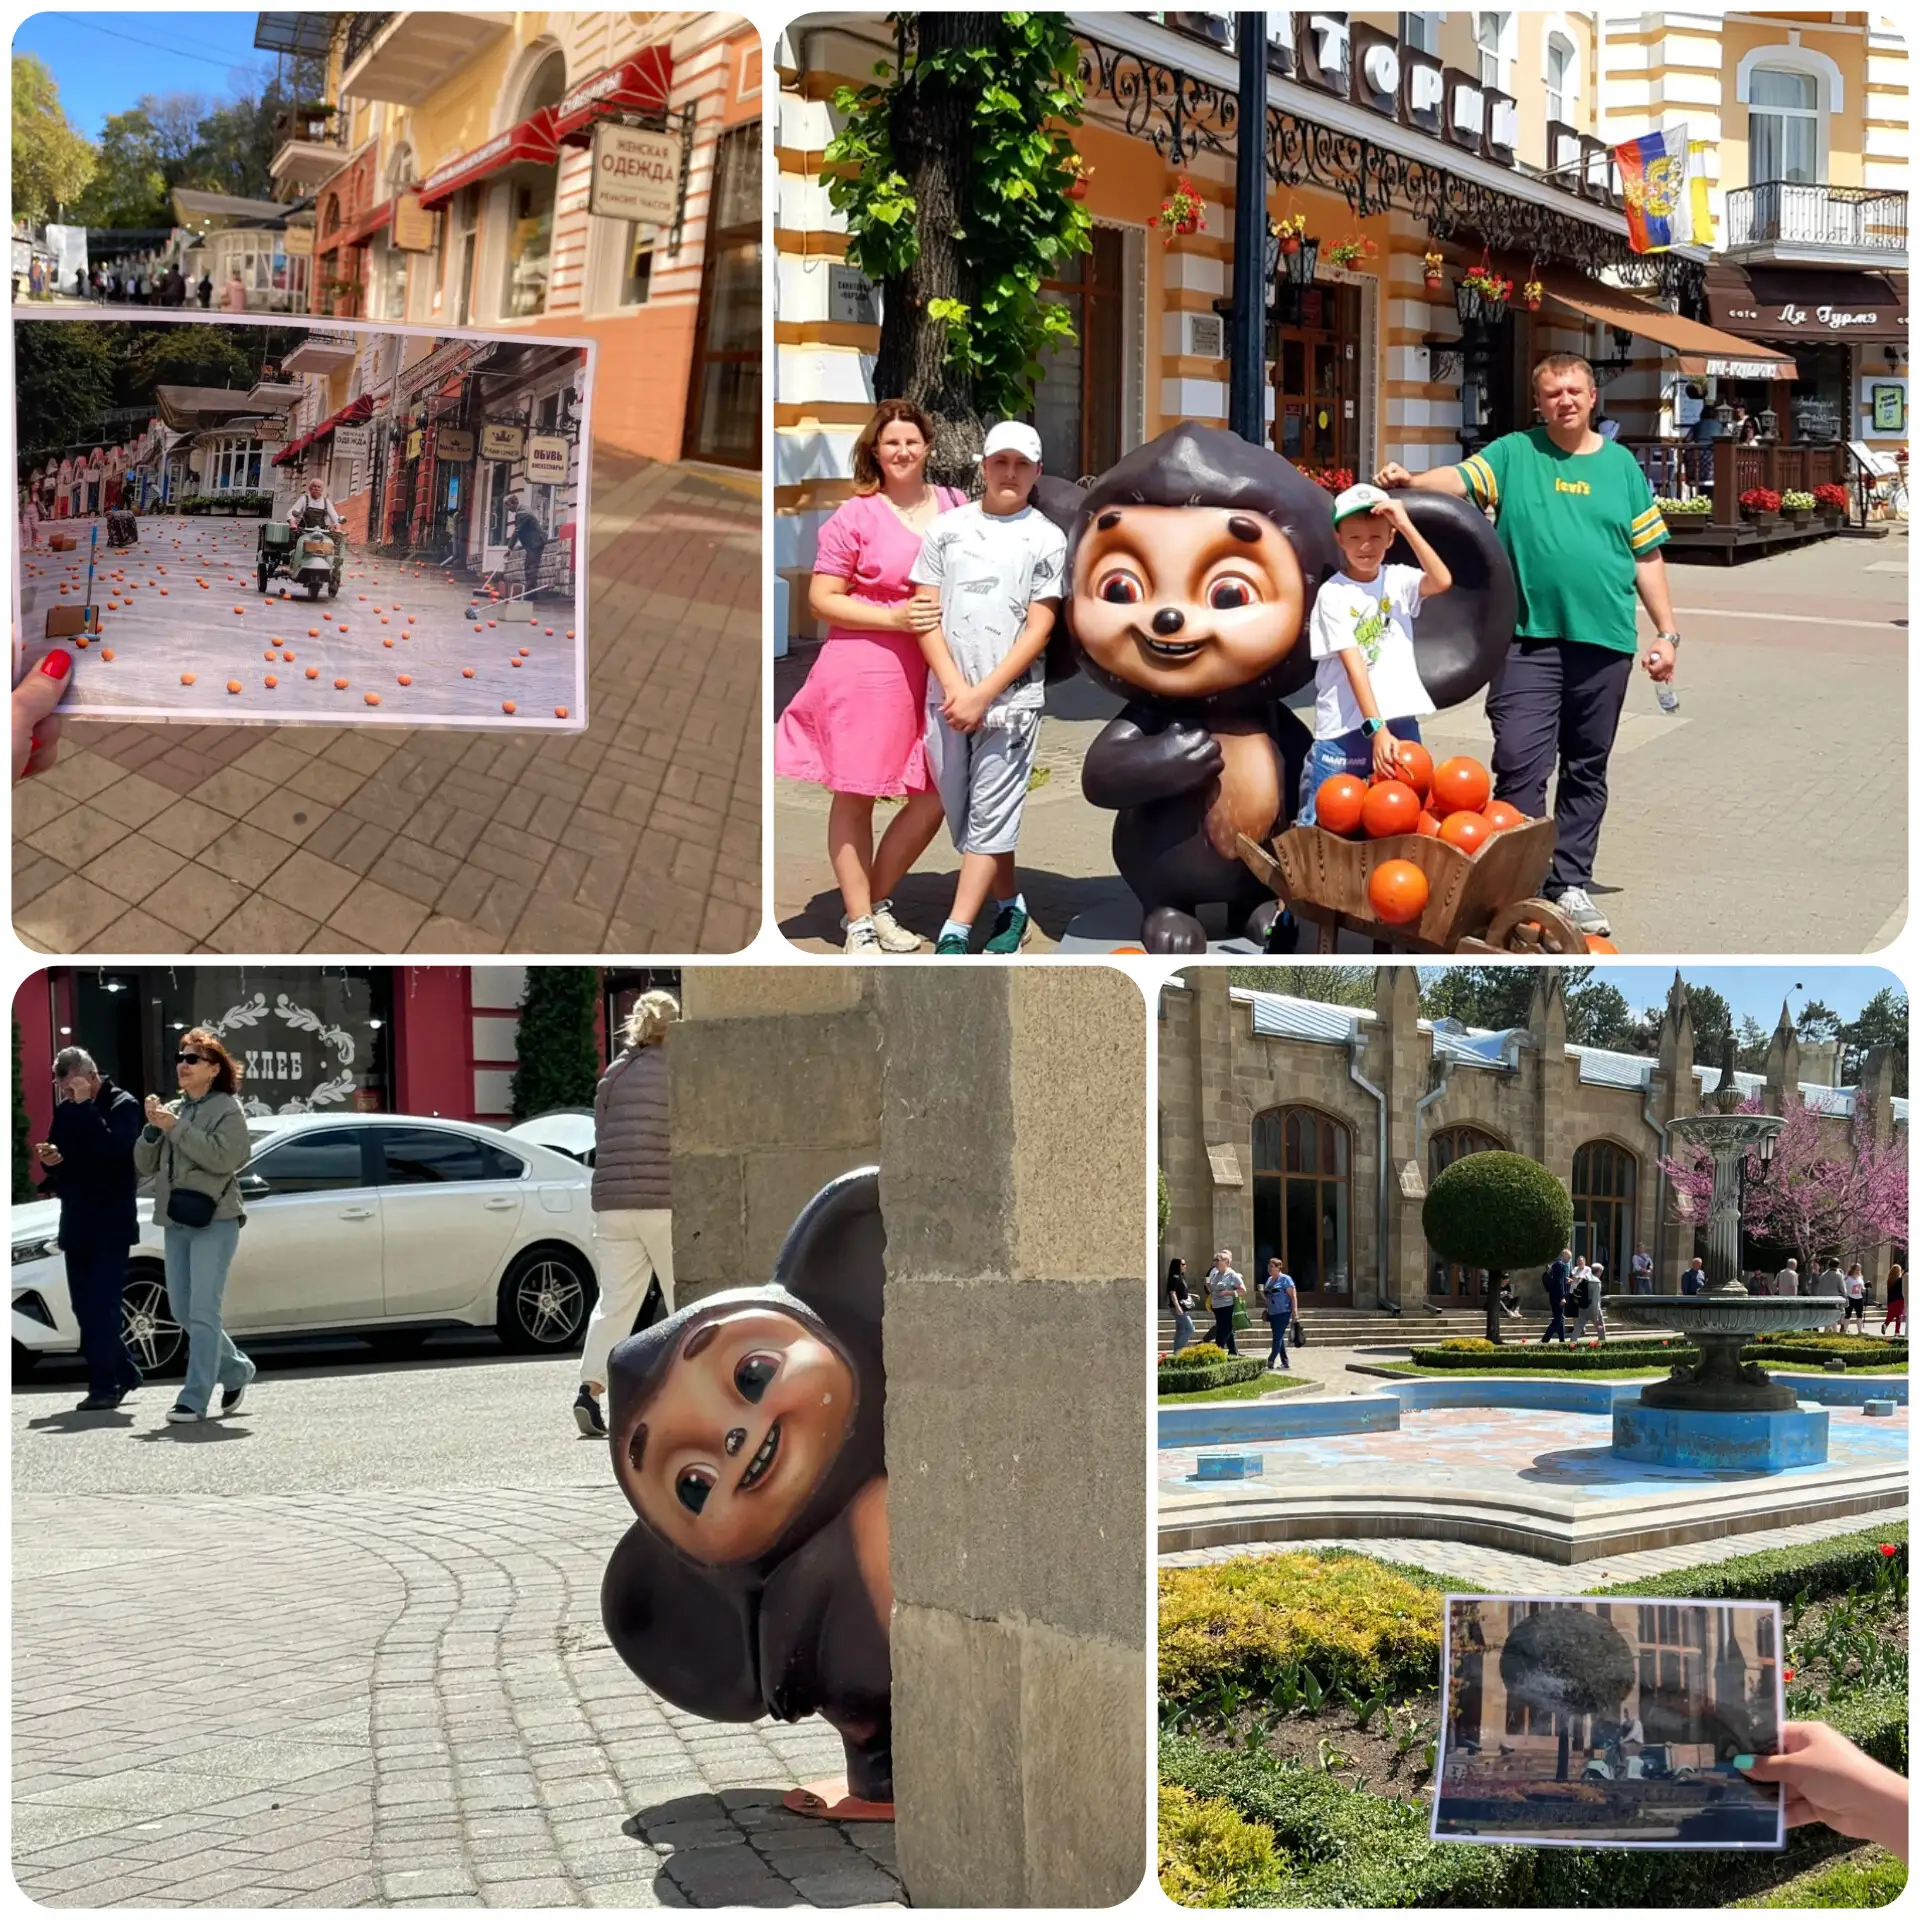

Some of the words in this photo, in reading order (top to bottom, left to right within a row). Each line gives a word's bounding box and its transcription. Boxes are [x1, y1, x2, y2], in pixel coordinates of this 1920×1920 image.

[617, 140, 668, 158] ЖЕНСКАЯ
[602, 154, 674, 183] ОДЕЖДА
[1777, 304, 1807, 325] Ля
[1816, 306, 1877, 328] Гурмэ
[533, 449, 563, 461] ОБУВЬ
[245, 1051, 302, 1080] ХЛЕБ
